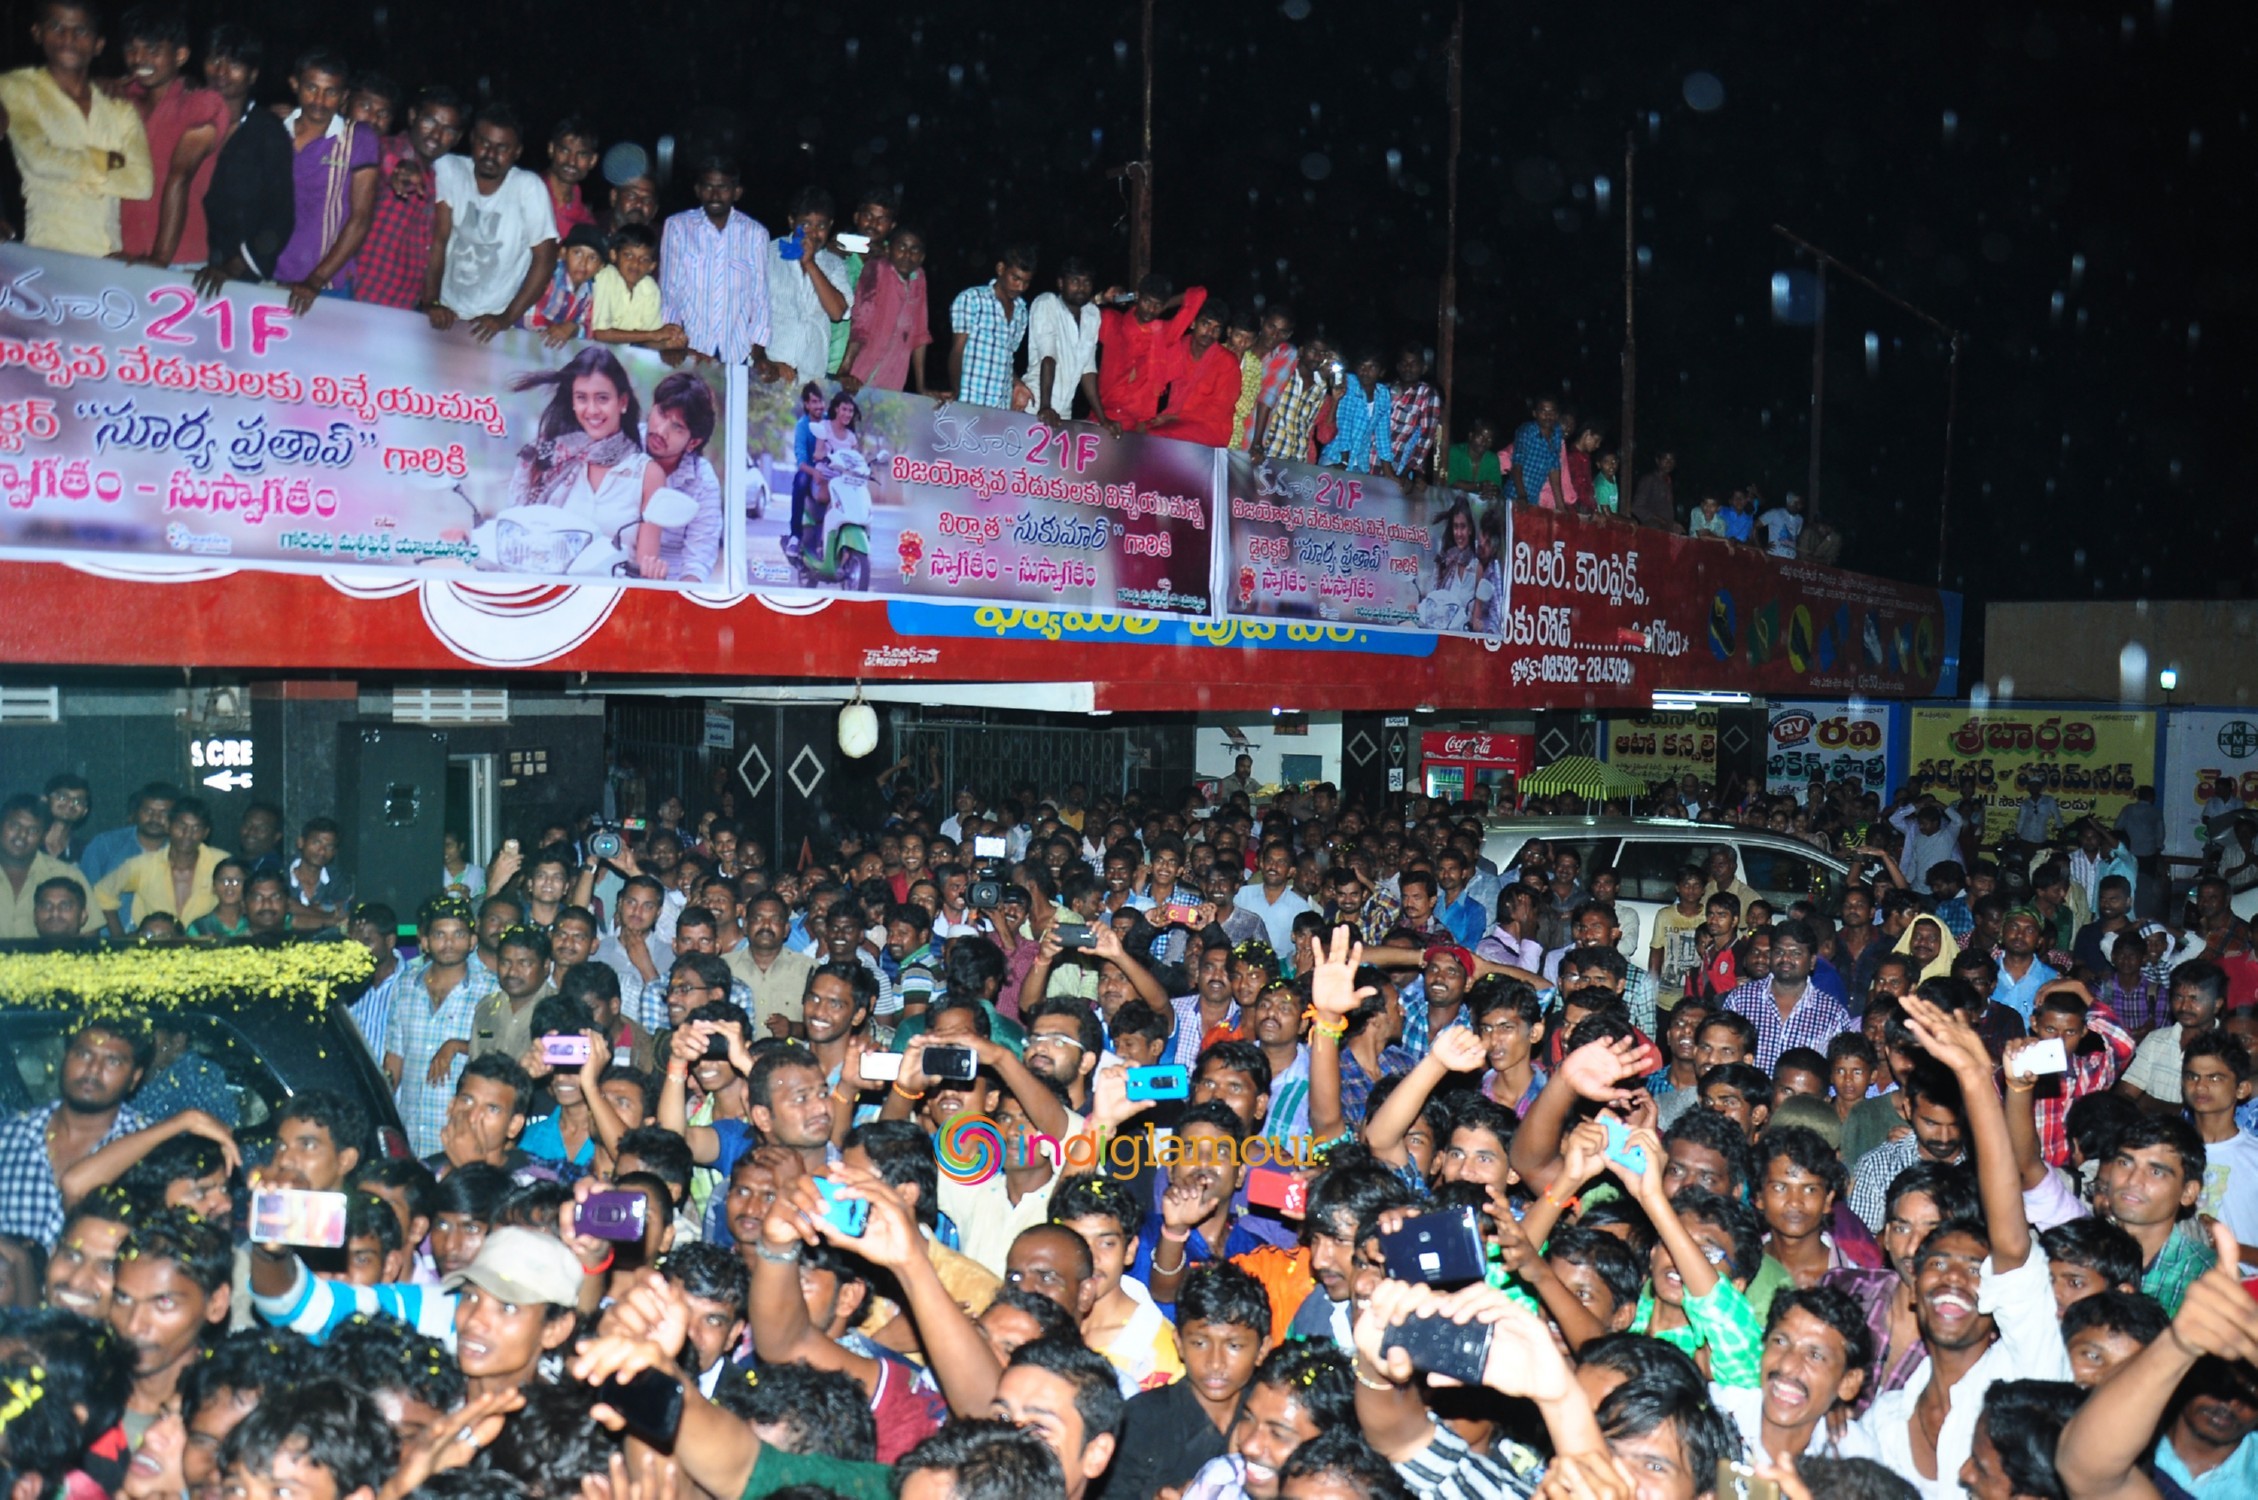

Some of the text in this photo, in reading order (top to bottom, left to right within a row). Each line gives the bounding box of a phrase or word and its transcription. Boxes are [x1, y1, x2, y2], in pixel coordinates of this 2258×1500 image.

[146, 285, 295, 355] 21F
[383, 444, 468, 477] గారికి
[1026, 424, 1100, 472] 21F
[165, 469, 338, 524] సుస్వాగతం
[892, 455, 1006, 498] విజయోత్సవ
[1314, 472, 1364, 510] 21F
[938, 511, 1001, 545] నిర్మాత
[1124, 531, 1172, 558] గారికి
[929, 549, 998, 585] స్వాగతం
[1017, 557, 1097, 592] సుస్వాగతం
[1778, 719, 1804, 737] RV
[1818, 716, 1881, 747] రవి
